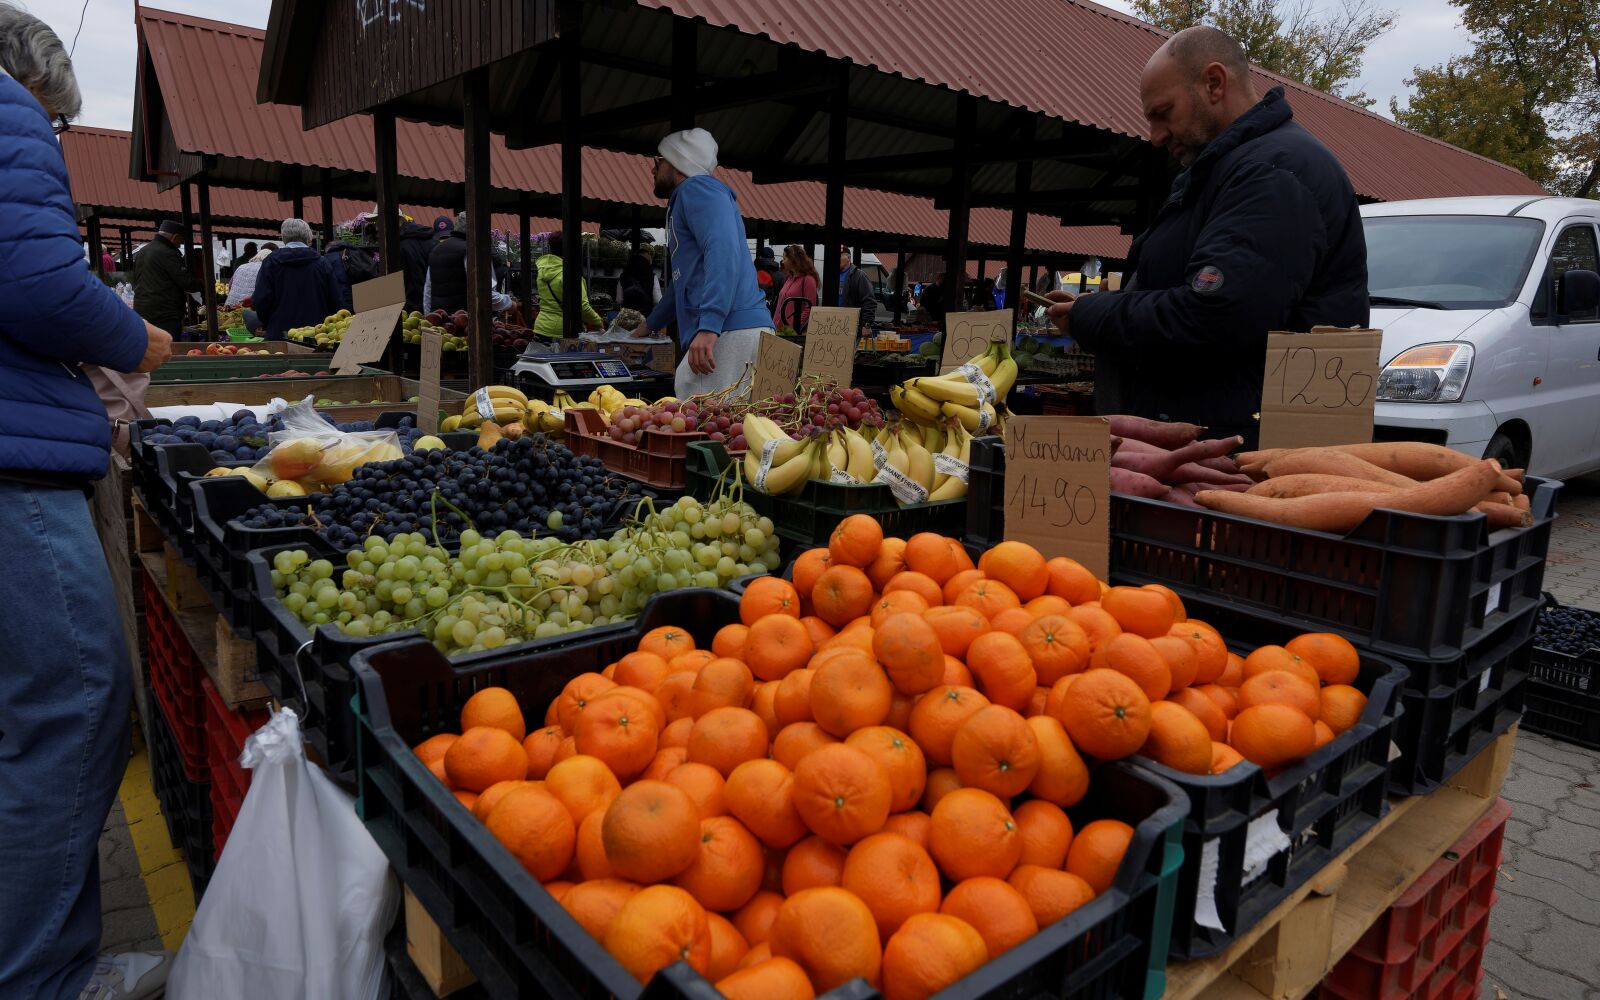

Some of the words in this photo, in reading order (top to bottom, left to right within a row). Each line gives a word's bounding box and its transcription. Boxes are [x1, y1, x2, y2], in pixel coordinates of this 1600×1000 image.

[808, 338, 847, 368] 1390
[1271, 347, 1373, 408] 1290
[1010, 474, 1097, 528] 1490
